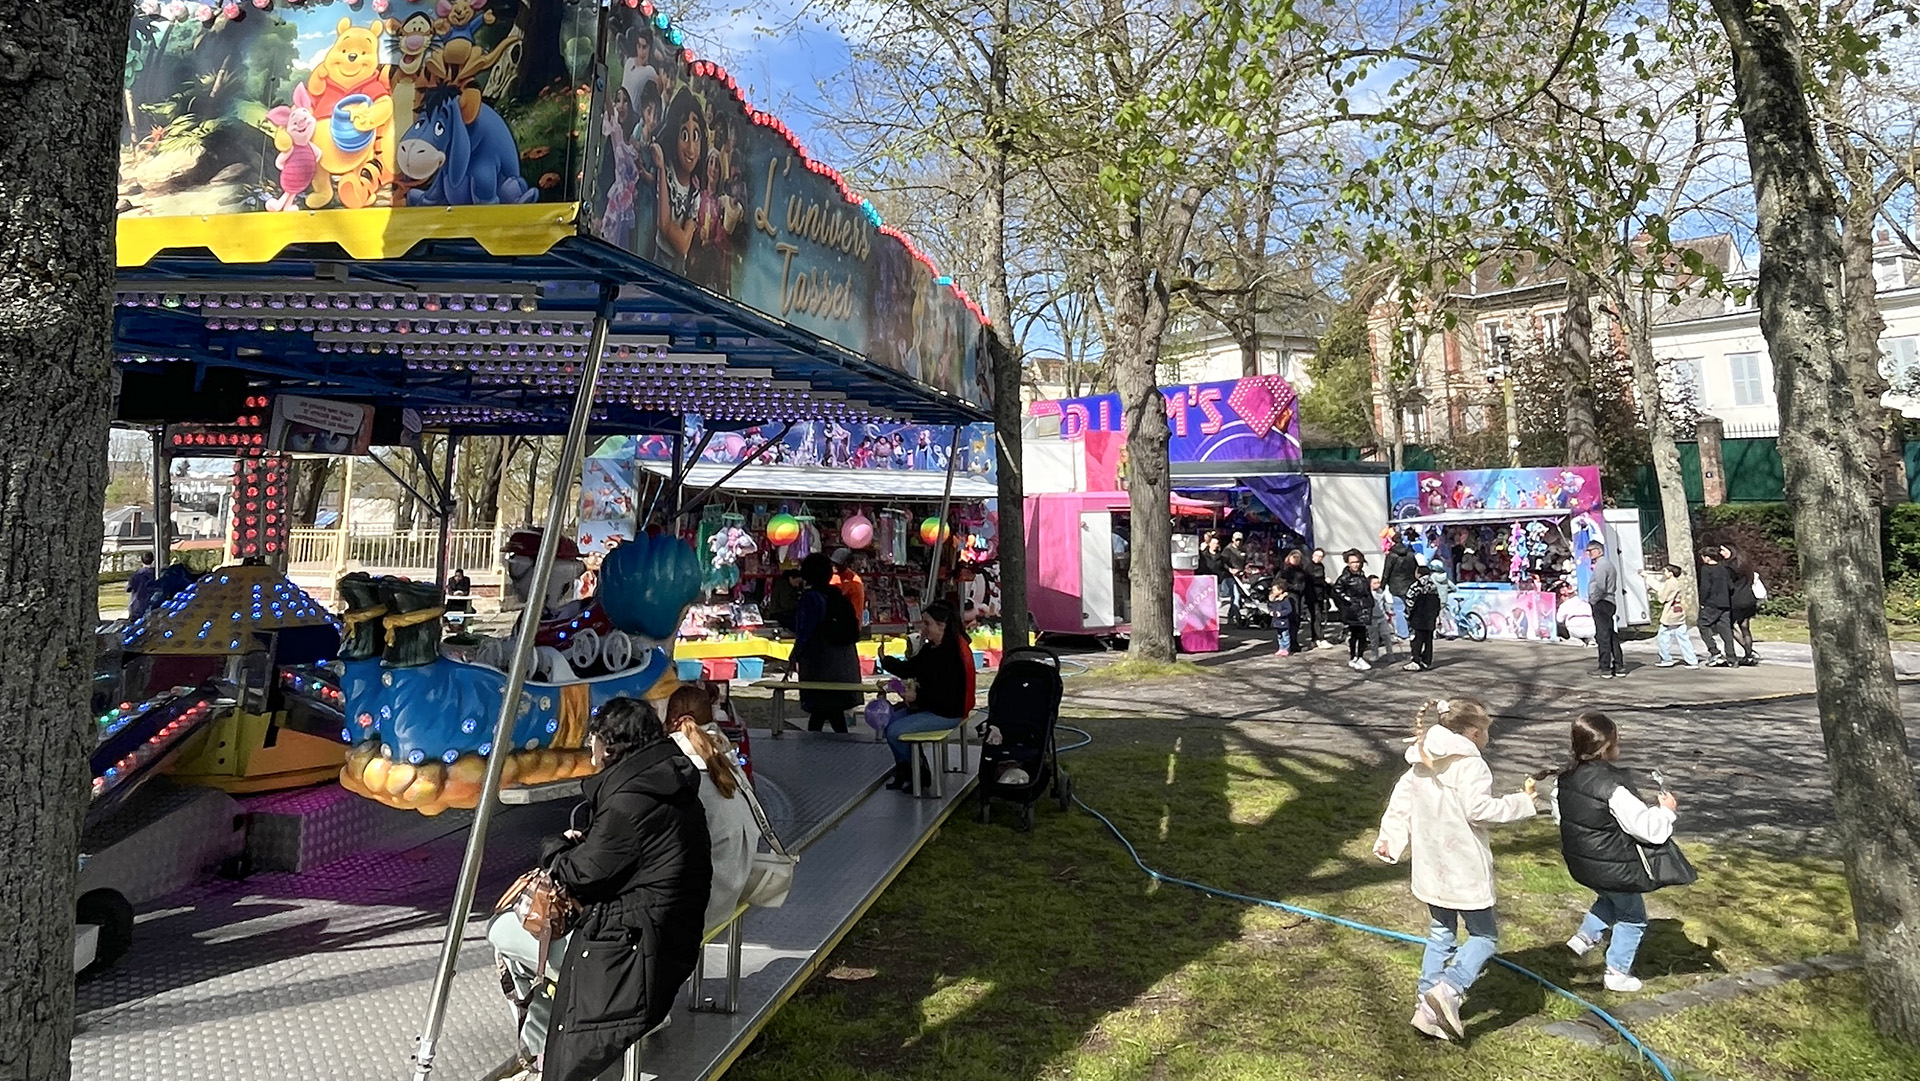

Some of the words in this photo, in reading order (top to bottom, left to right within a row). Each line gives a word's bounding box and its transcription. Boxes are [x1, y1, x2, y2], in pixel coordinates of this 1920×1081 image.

[754, 155, 871, 262] L'univers
[775, 241, 853, 321] Tasset
[1065, 384, 1222, 441] DIM'S
